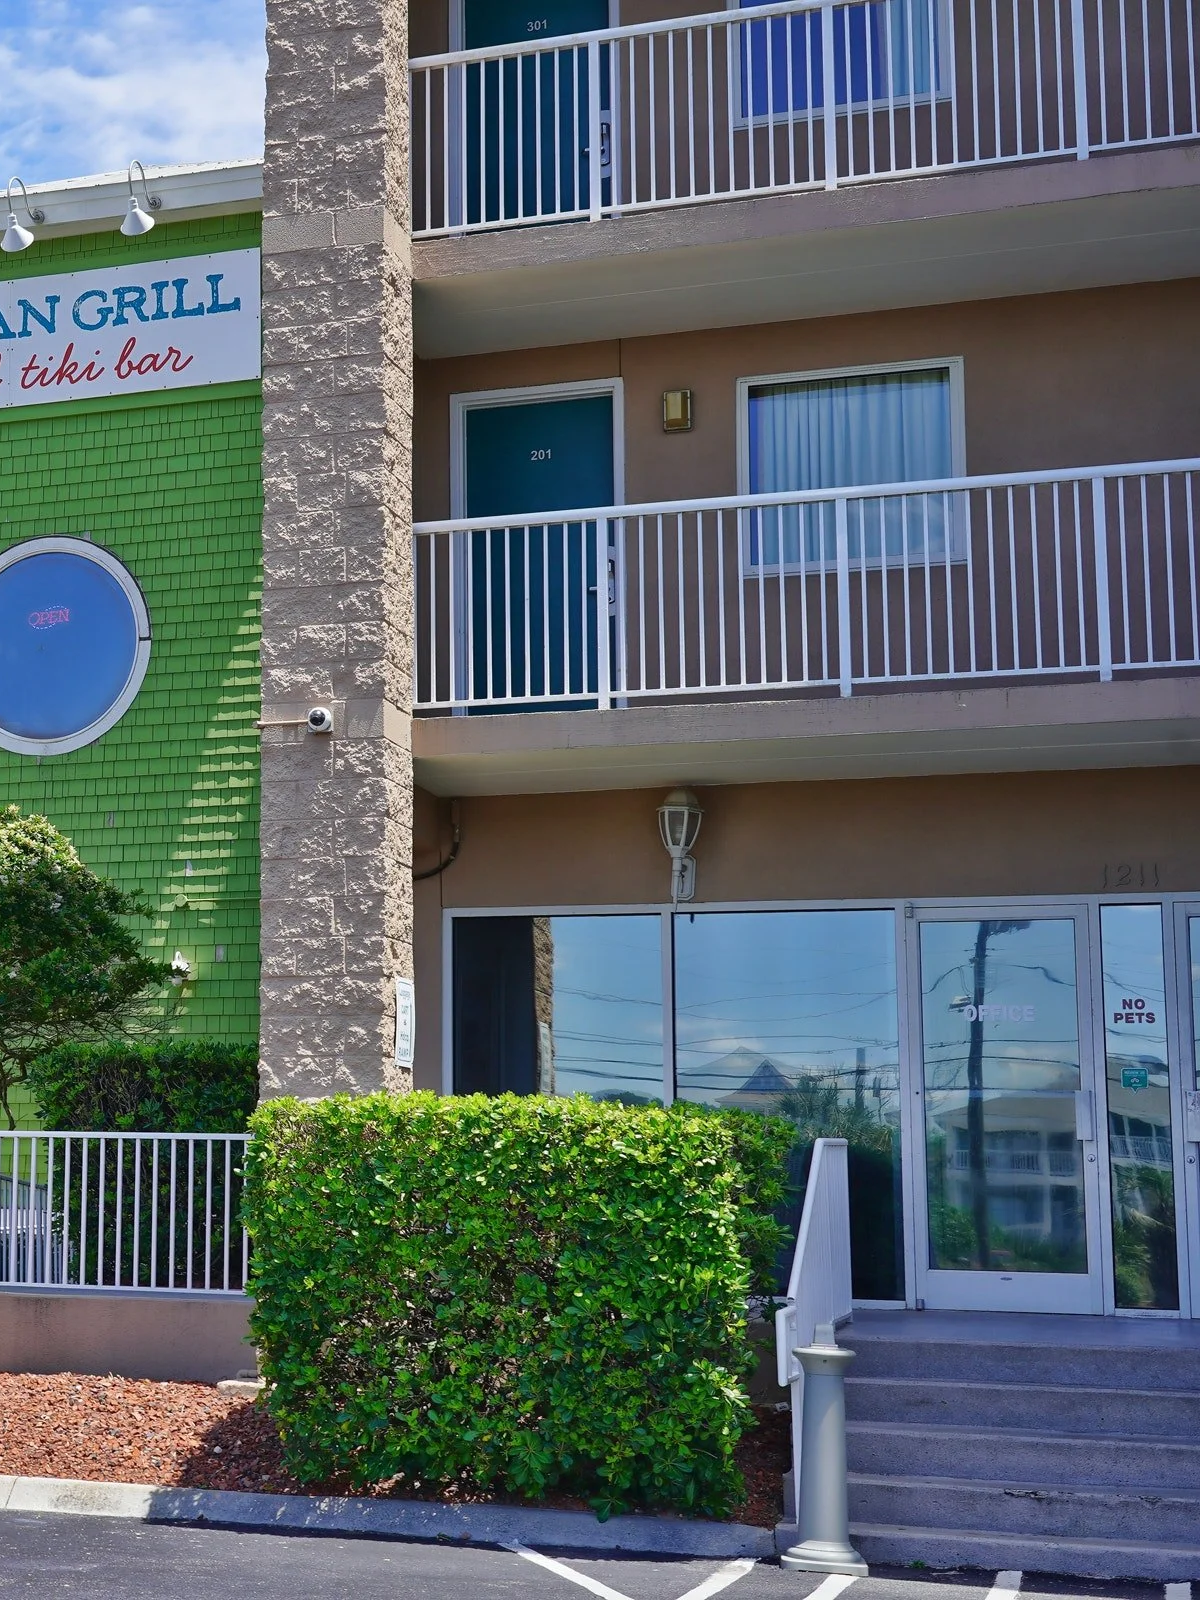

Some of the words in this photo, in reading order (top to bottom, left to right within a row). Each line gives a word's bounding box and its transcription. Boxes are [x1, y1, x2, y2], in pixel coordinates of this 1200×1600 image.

[527, 19, 547, 32] 301
[72, 273, 241, 331] GRILL
[20, 342, 106, 389] tiki
[114, 336, 195, 381] bar
[531, 449, 551, 461] 201
[28, 608, 70, 627] OPEN
[1103, 863, 1160, 888] 1211
[964, 1004, 1036, 1022] OFFICE
[1122, 998, 1146, 1010] NO
[1114, 1012, 1156, 1024] PETS
